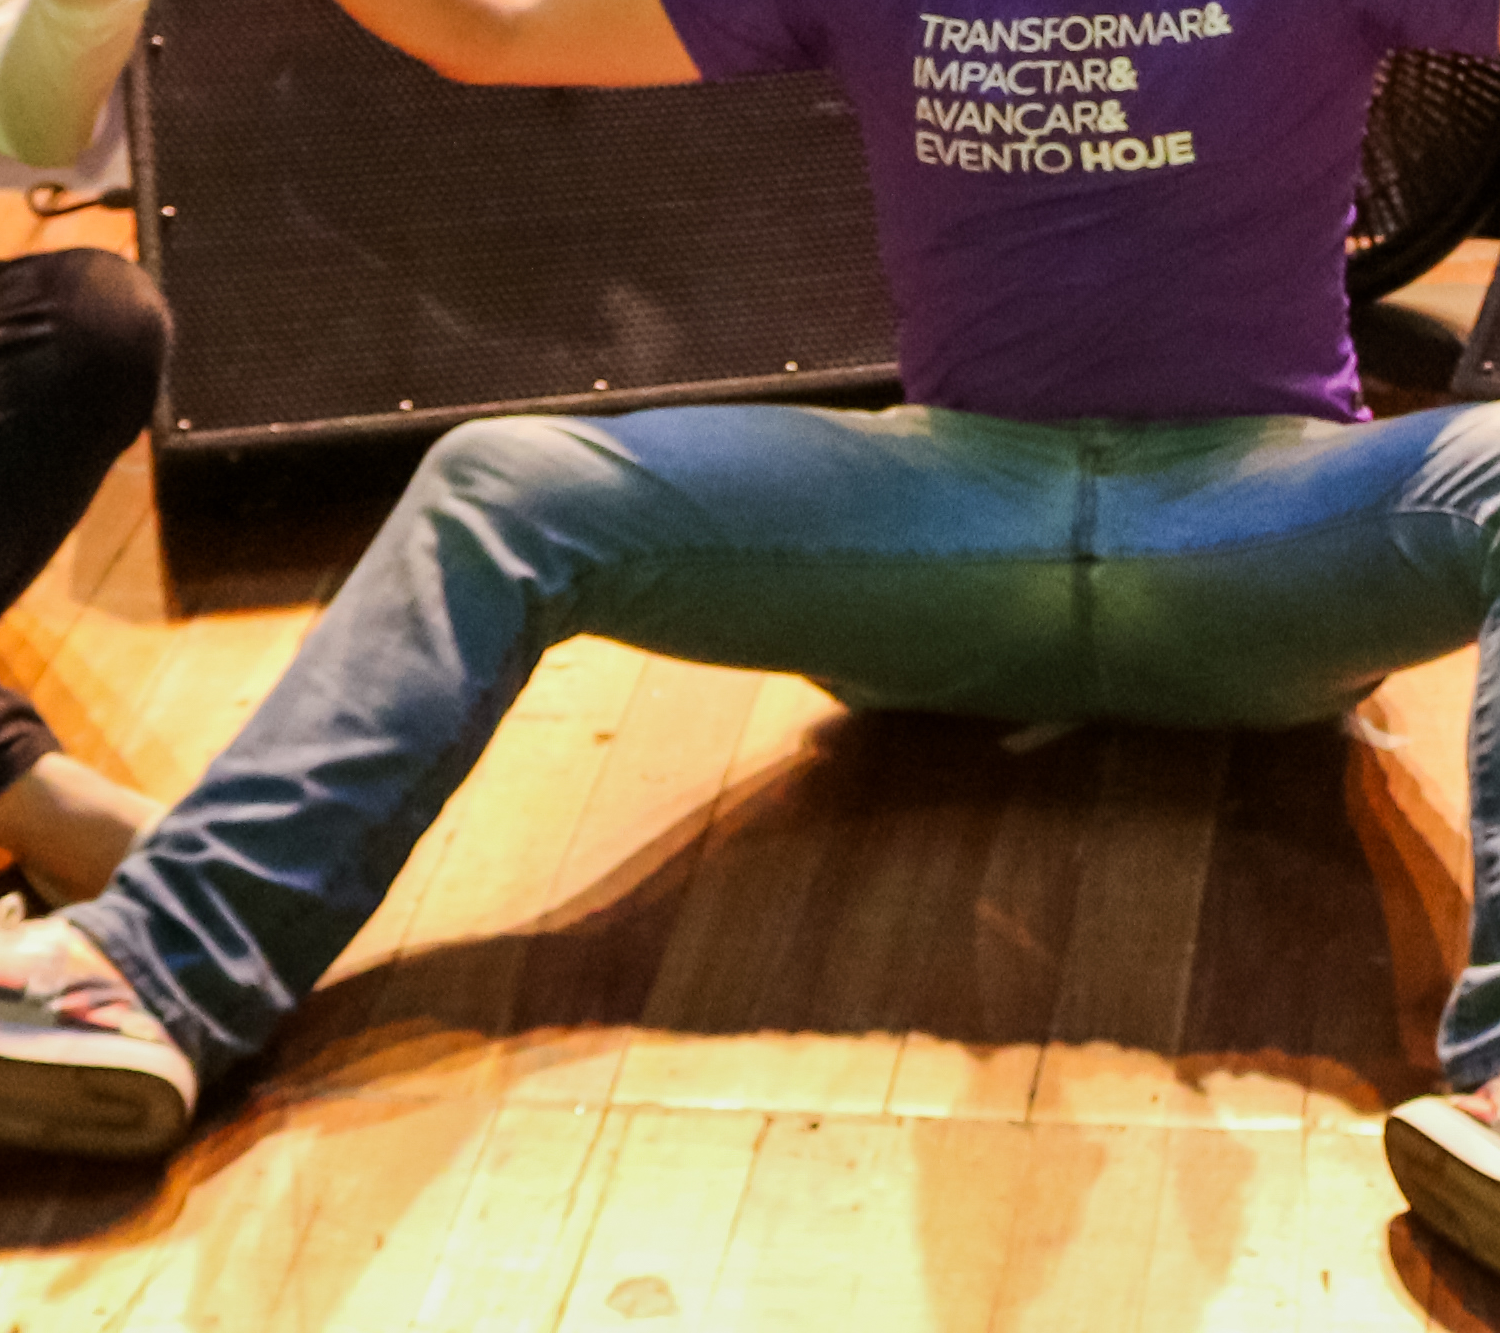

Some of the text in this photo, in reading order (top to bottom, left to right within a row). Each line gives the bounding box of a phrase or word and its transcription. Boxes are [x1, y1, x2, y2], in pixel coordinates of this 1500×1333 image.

[918, 1, 1233, 54] TRANSFORMAR&
[913, 55, 1139, 96] IMPACTAR&
[914, 96, 1130, 143] AVANÇAR&
[914, 130, 1197, 174] EVENTO HOJE
